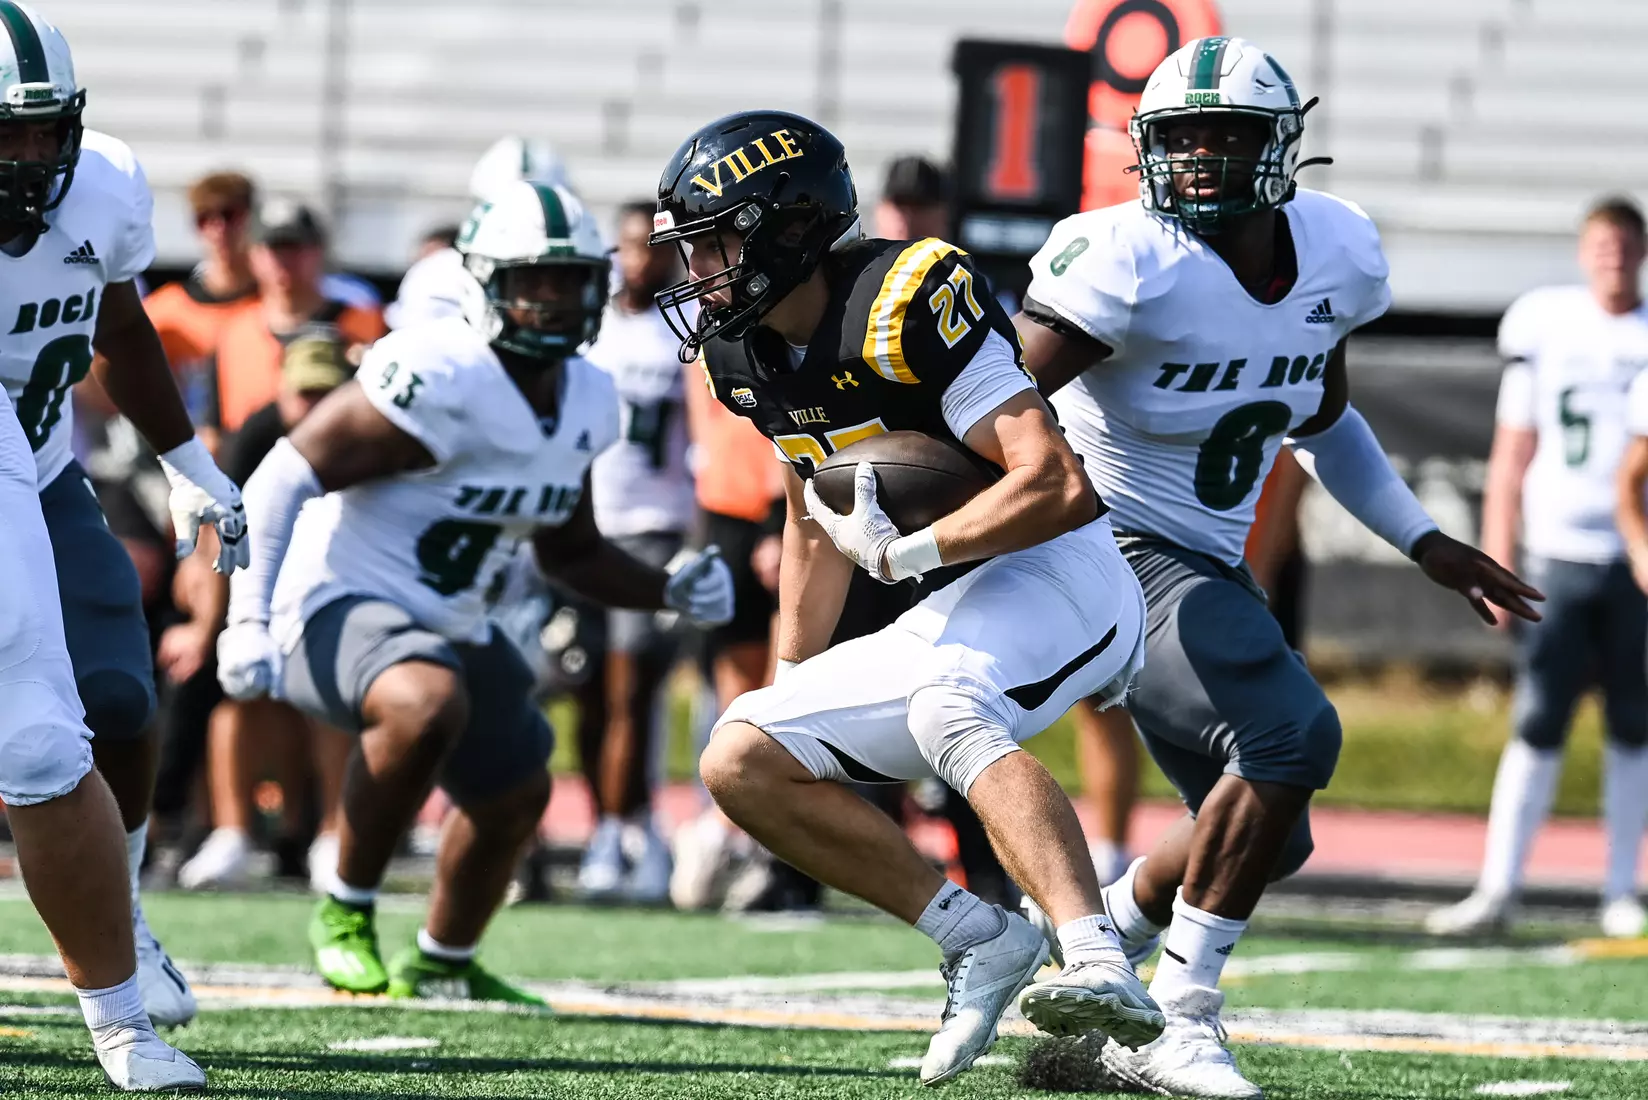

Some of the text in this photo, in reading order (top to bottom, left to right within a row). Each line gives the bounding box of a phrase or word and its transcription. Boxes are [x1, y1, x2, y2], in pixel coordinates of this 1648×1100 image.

[1185, 92, 1220, 105] ROCK
[988, 66, 1038, 196] 1
[690, 129, 804, 197] VILLE
[1050, 236, 1090, 277] 8
[929, 263, 985, 349] 27
[1152, 351, 1334, 393] THE ROC
[788, 406, 830, 426] VILLE
[1194, 400, 1292, 511] 8
